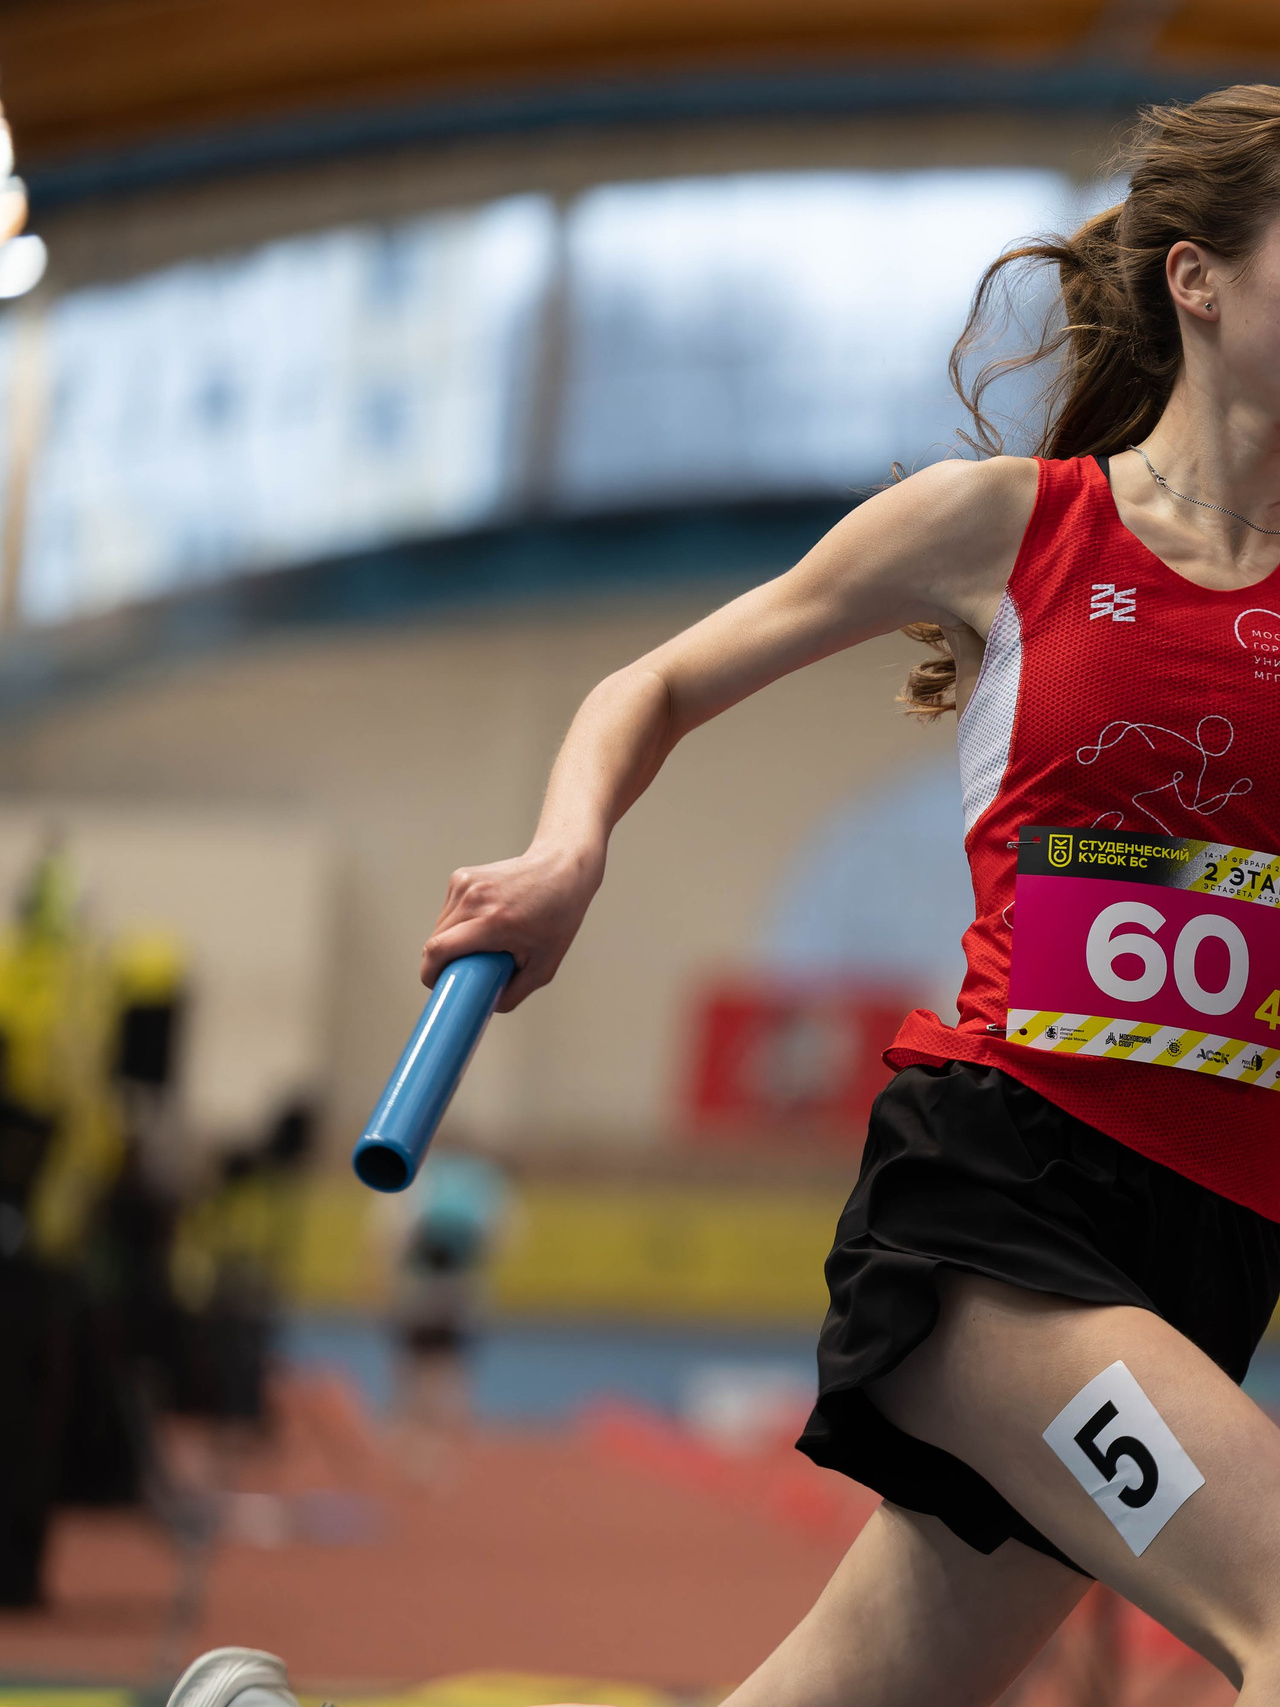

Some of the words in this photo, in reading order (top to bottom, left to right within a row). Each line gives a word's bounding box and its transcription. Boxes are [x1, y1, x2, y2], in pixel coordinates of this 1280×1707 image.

[1078, 839, 1190, 862] СТУДЕНЧЕСКИЙ
[1078, 852, 1127, 867] КУБОК
[1129, 856, 1148, 869] БС
[1204, 852, 1228, 861] 14-15
[1231, 857, 1272, 870] ФЕВРАЛЯ
[1204, 862, 1218, 882] 2
[1203, 882, 1253, 898] ЭСТАФЕТА
[1086, 901, 1250, 1016] 60
[1118, 1033, 1152, 1045] МОСКОВСКИЙ
[1118, 1040, 1134, 1049] СПОРТ
[1073, 1400, 1159, 1509] 5
